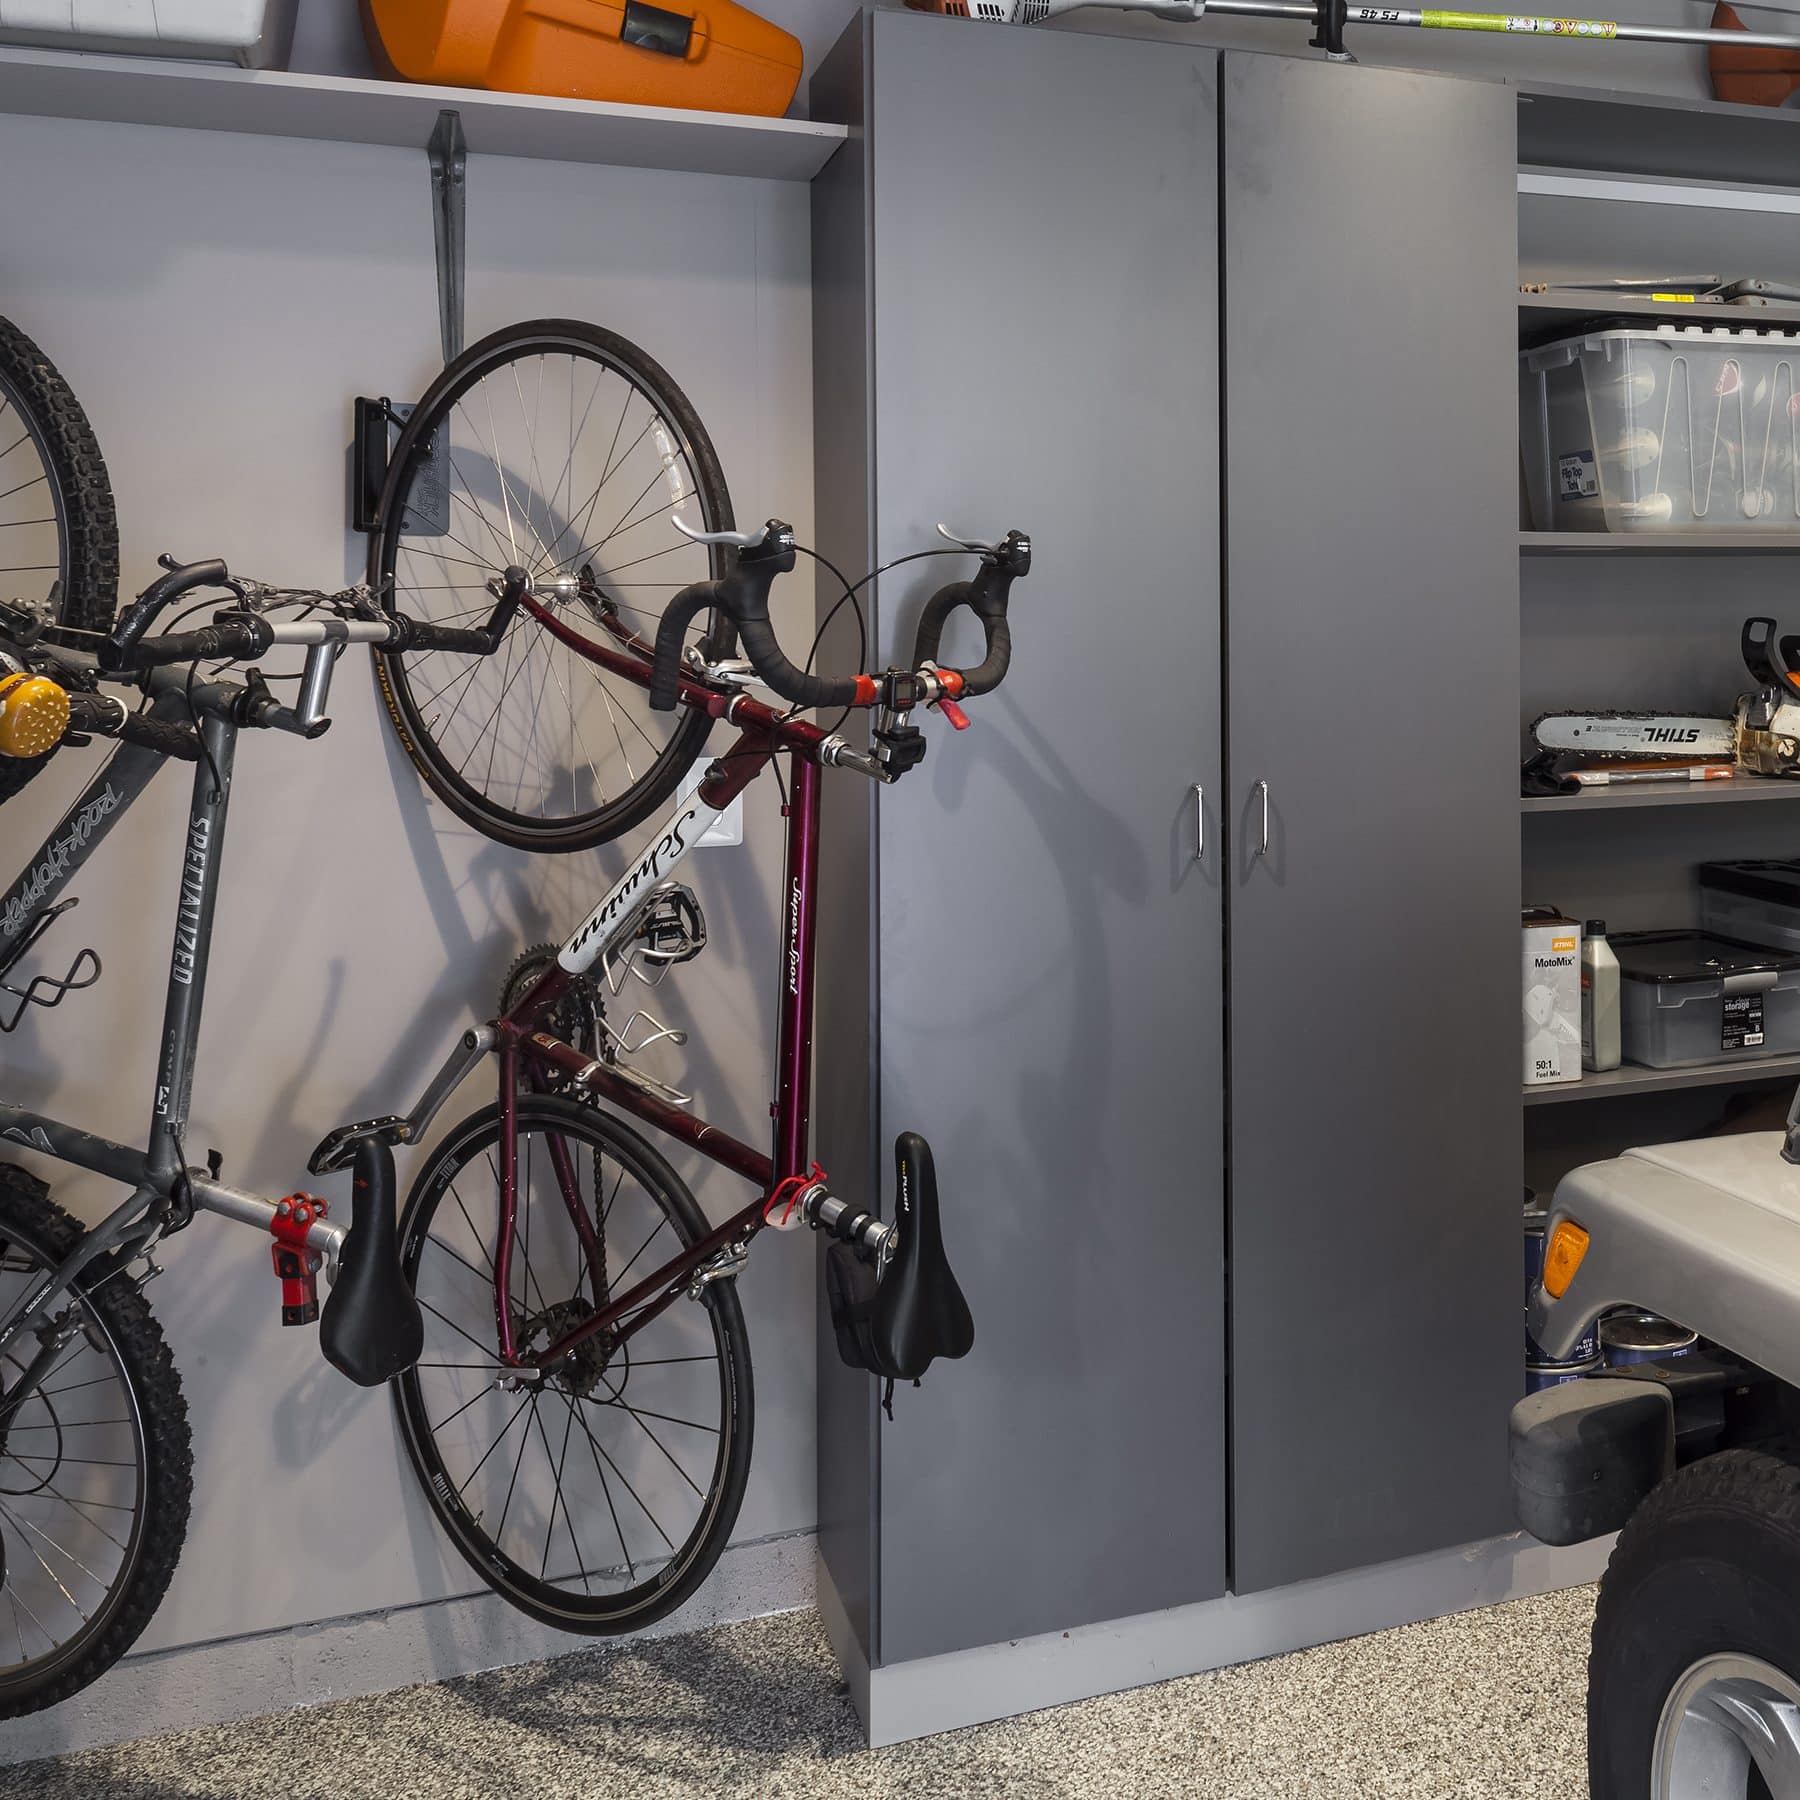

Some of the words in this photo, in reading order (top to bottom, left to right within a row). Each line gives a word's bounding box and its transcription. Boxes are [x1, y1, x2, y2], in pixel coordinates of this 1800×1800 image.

[1359, 9, 1378, 19] 46
[1381, 10, 1400, 21] FS
[1643, 727, 1701, 743] STIHL
[569, 809, 697, 955] Schwinn
[172, 815, 211, 986] SPECIALIZED
[790, 876, 802, 937] Super
[788, 938, 801, 995] Sport
[1534, 956, 1573, 968] MotoMix
[1724, 1001, 1750, 1011] storage
[1535, 1060, 1552, 1070] 50:1
